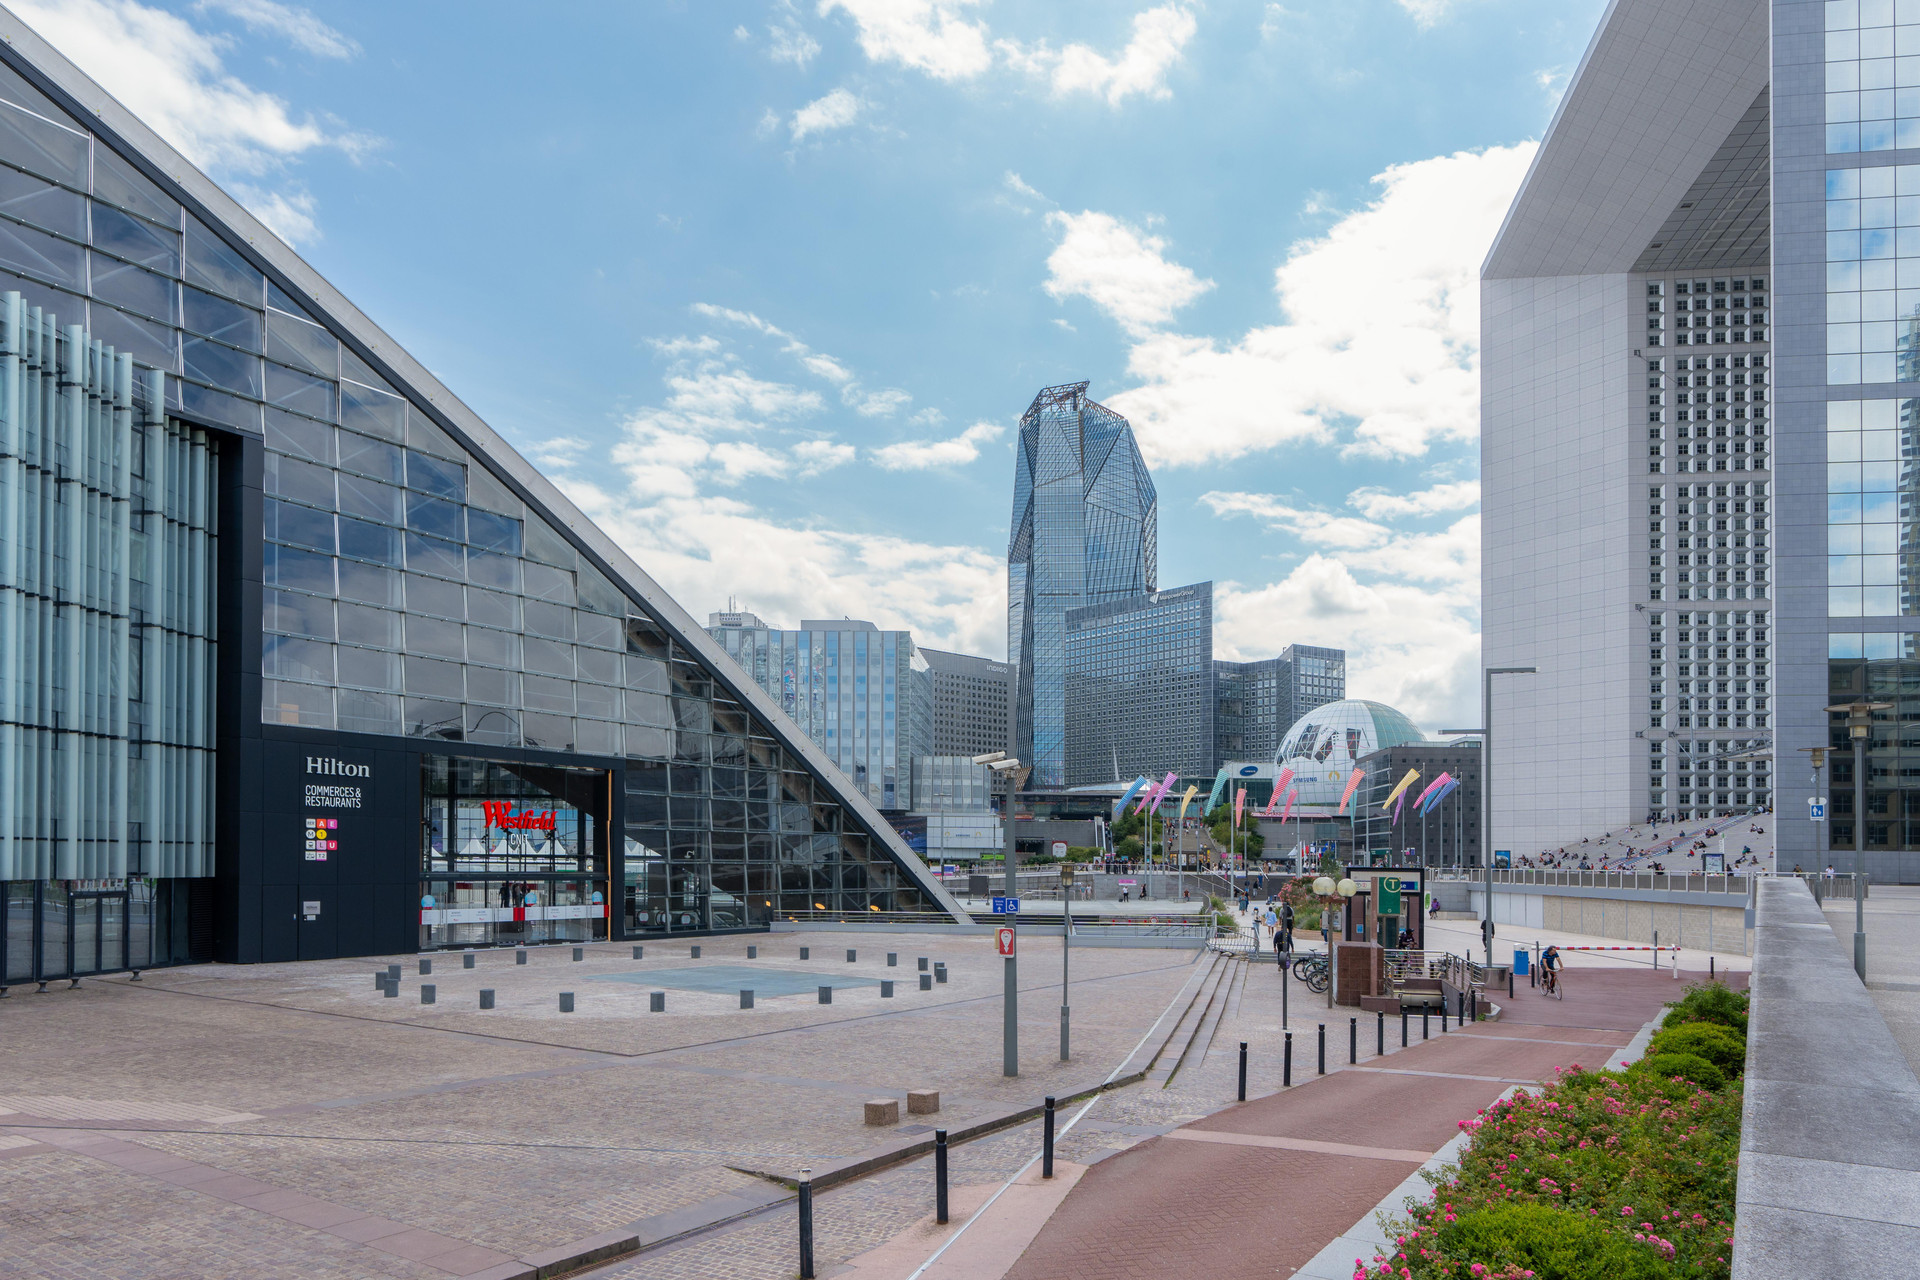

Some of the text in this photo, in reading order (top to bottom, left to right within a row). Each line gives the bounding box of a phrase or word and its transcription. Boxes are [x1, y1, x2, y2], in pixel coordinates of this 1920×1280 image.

[986, 664, 1008, 674] INDIGO
[306, 756, 370, 778] Hilton
[1293, 776, 1318, 784] SAMSUNG
[306, 785, 362, 798] COMMERCES &
[305, 796, 361, 808] RESTAURANTS
[480, 799, 559, 831] Westfield
[510, 833, 529, 846] CNIT
[1388, 879, 1398, 890] T
